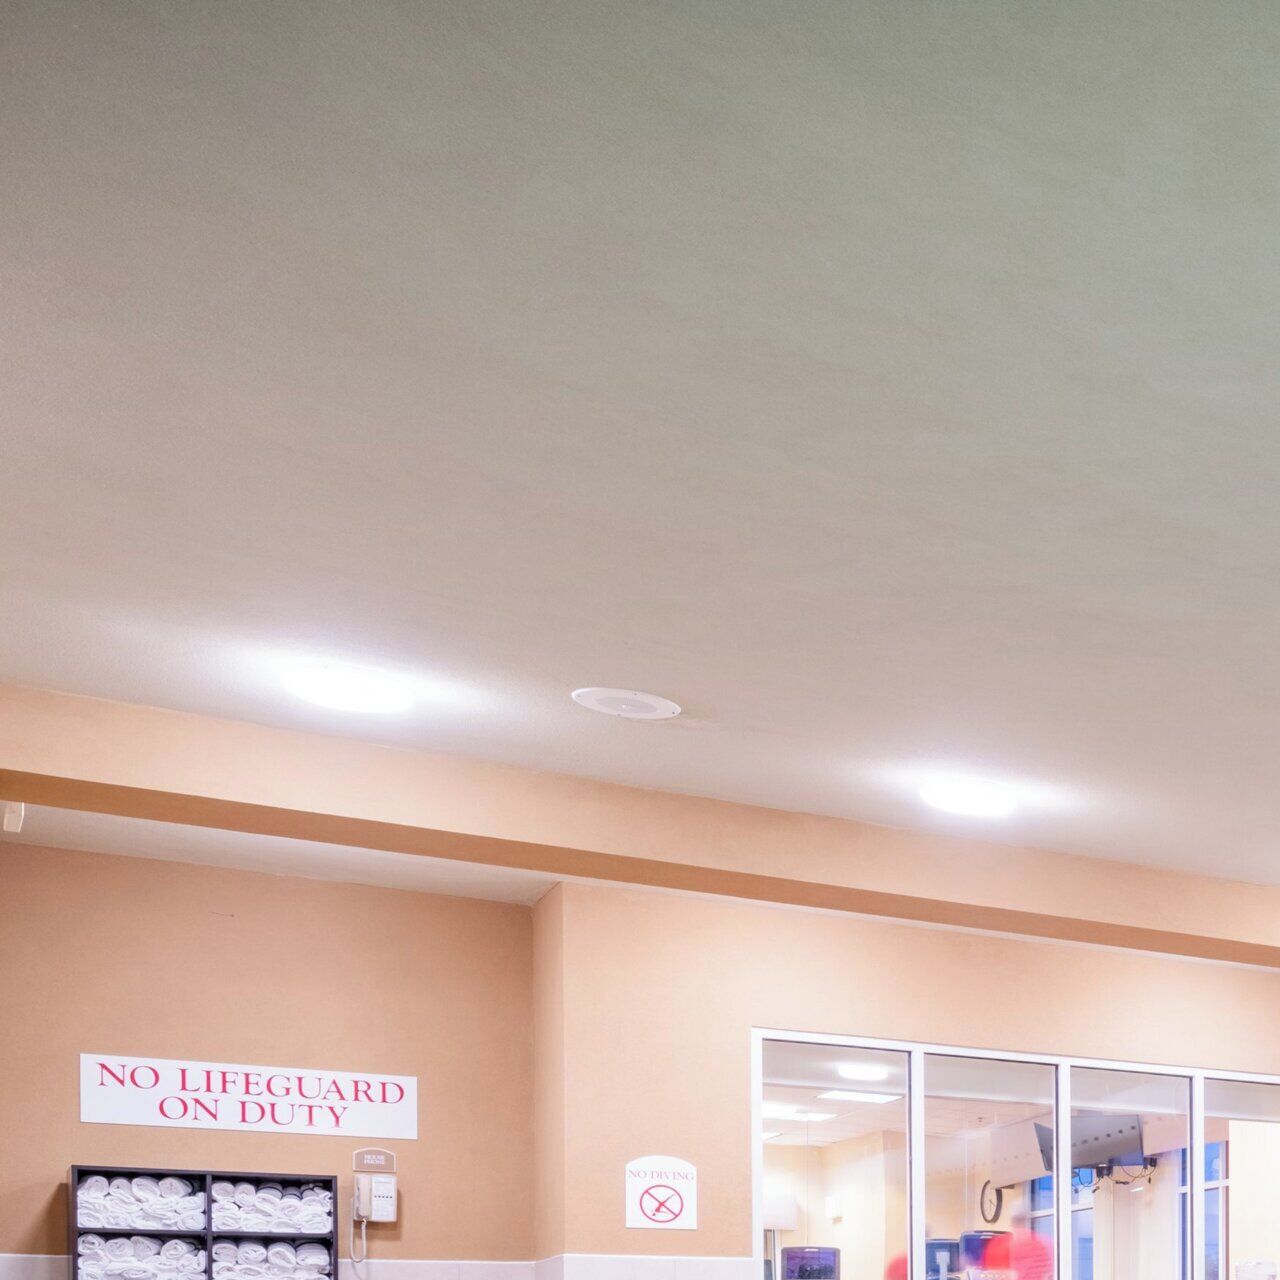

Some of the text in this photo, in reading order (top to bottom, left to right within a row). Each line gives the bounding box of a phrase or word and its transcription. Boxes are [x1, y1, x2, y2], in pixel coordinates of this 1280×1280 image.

[96, 1062, 405, 1105] NO LIFEGUARD
[158, 1095, 349, 1128] ON DUTY
[629, 1169, 694, 1180] NO DIVING
